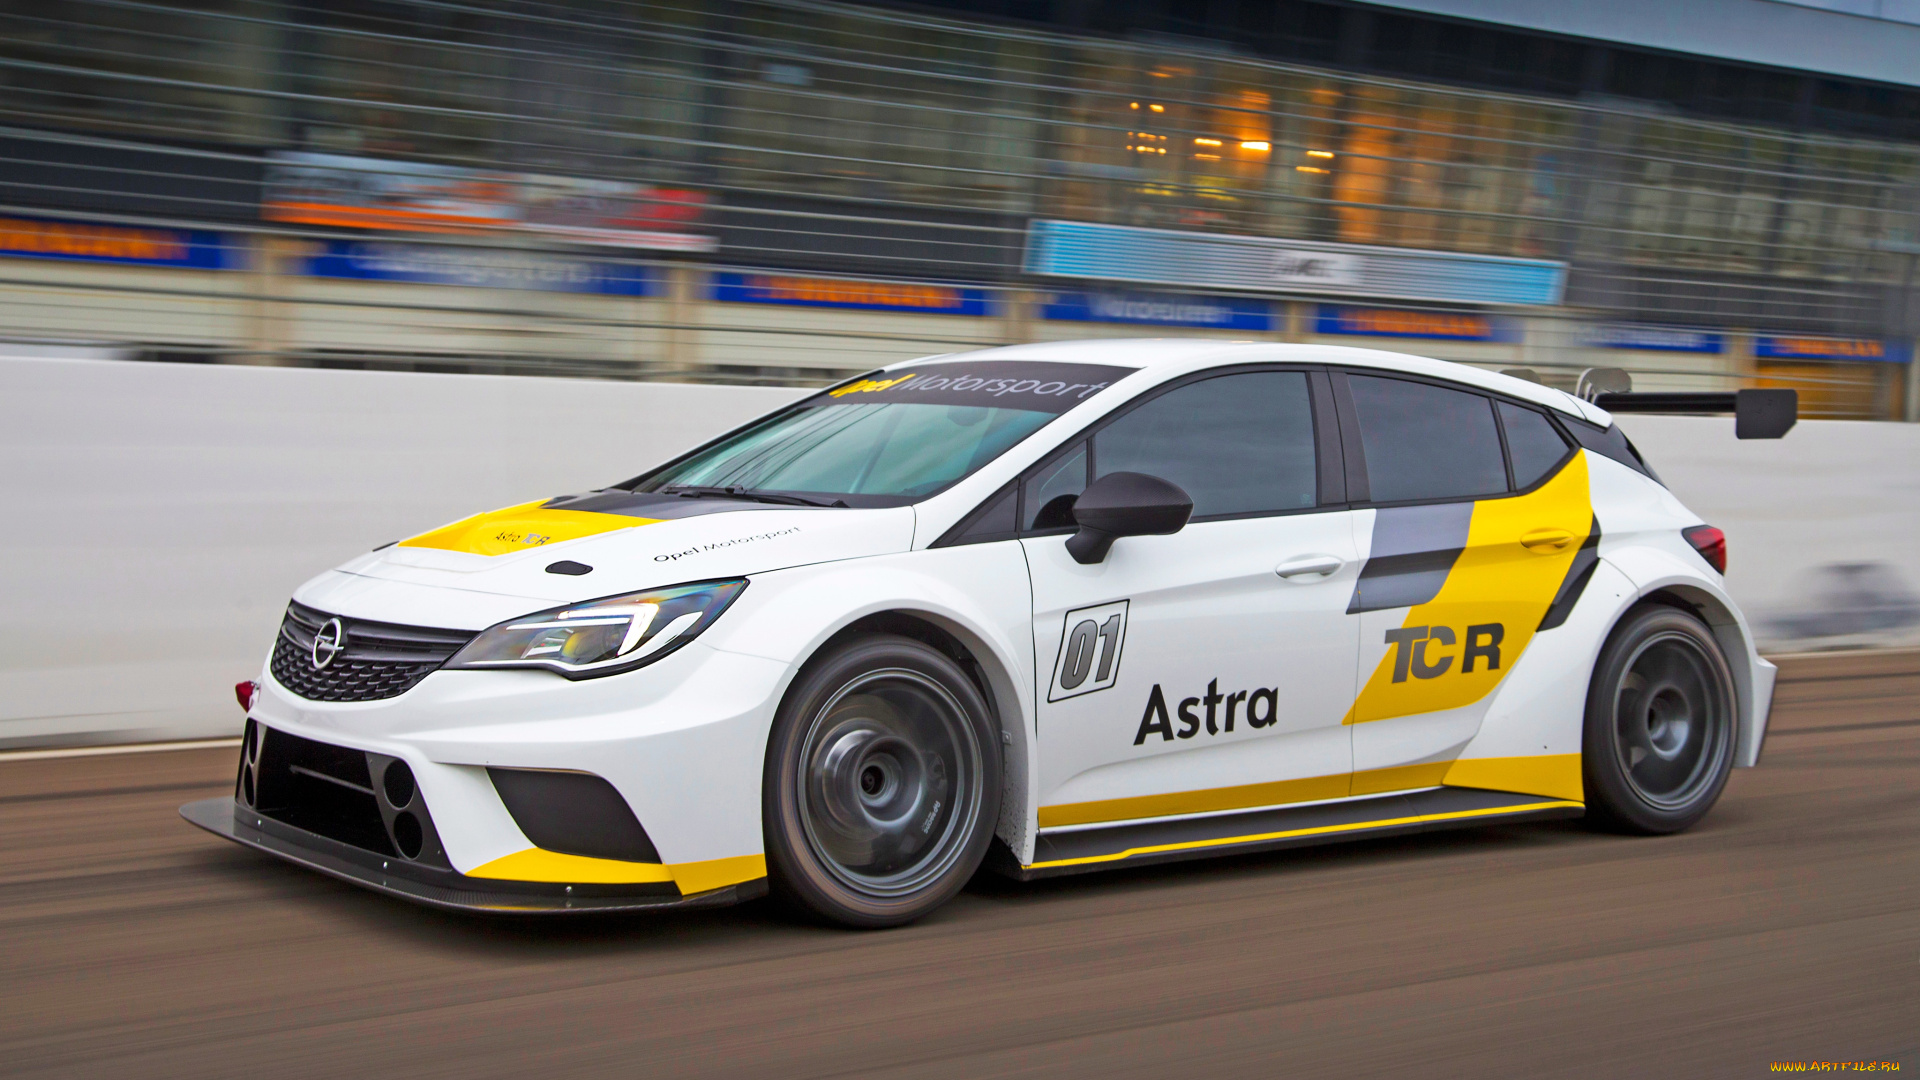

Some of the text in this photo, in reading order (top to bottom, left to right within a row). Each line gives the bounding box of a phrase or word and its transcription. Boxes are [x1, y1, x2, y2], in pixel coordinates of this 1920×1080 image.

[889, 374, 1108, 398] Motorsport
[653, 526, 802, 562] Opel Motorsport
[1060, 613, 1121, 690] 01
[1133, 677, 1278, 746] Astra
